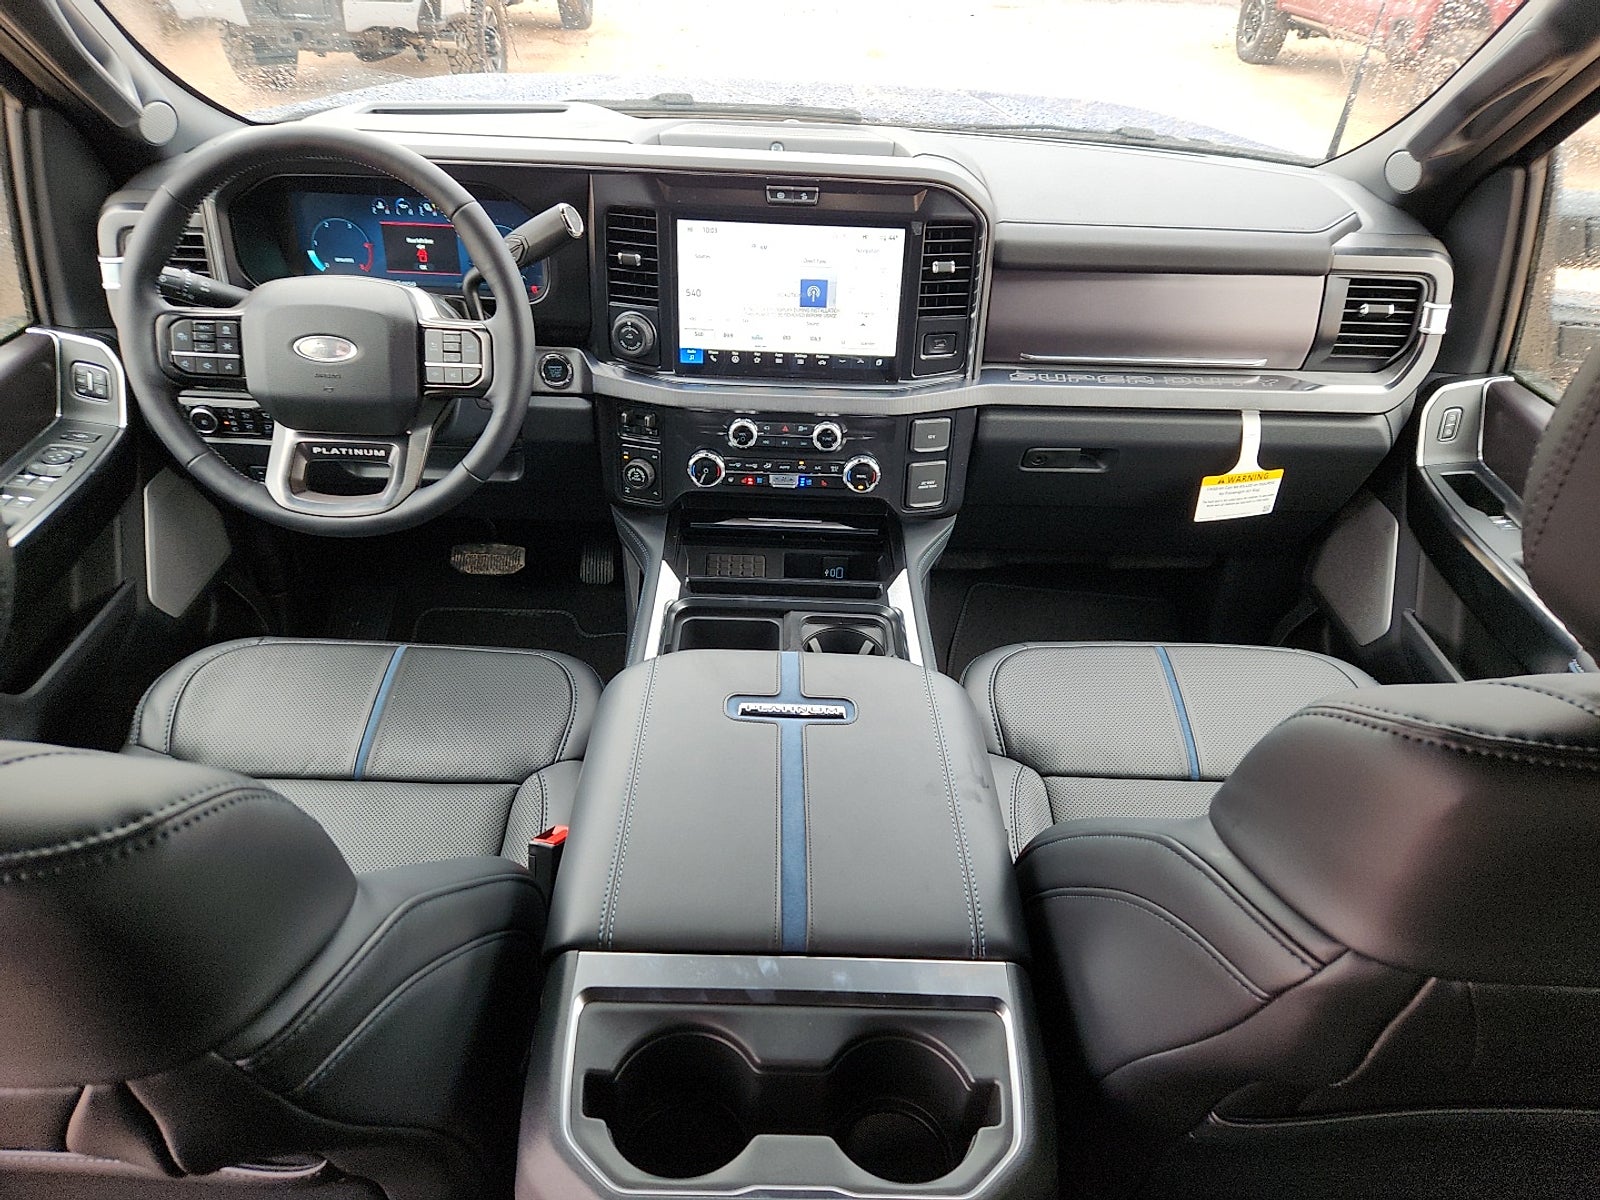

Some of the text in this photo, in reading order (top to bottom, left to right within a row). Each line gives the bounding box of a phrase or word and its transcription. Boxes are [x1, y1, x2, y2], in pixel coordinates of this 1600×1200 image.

[685, 288, 702, 298] 540
[1009, 370, 1155, 386] SUPER
[312, 446, 386, 457] PLATINUM
[1227, 472, 1270, 484] WARNING
[742, 703, 842, 715] PLATINUM
